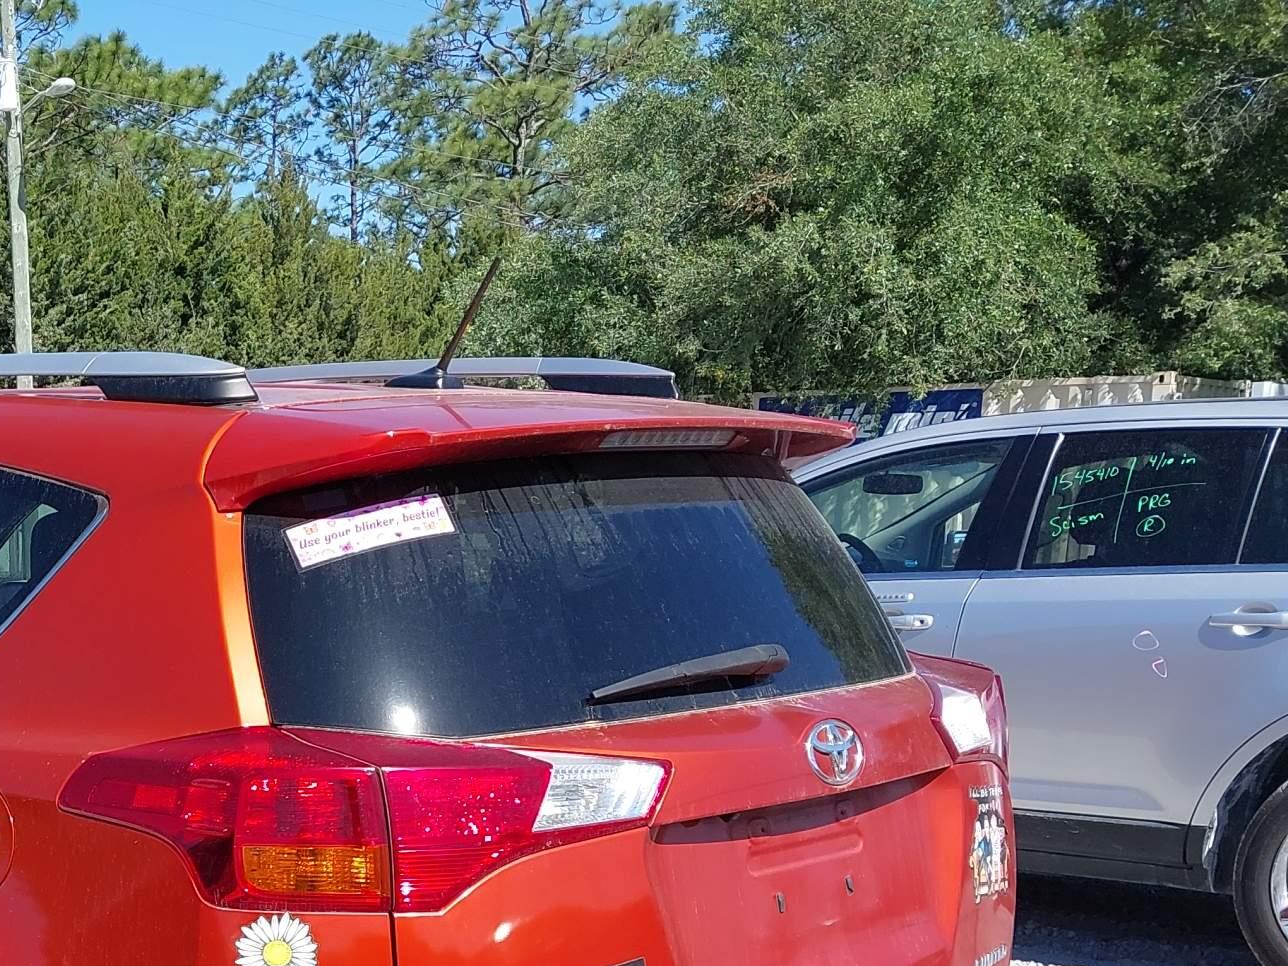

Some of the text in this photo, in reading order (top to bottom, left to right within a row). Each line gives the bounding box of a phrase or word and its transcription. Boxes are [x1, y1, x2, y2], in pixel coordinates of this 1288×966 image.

[1050, 466, 1120, 497] 1545410
[1137, 493, 1171, 512] PRG
[298, 530, 322, 550] Use
[323, 528, 352, 545] your
